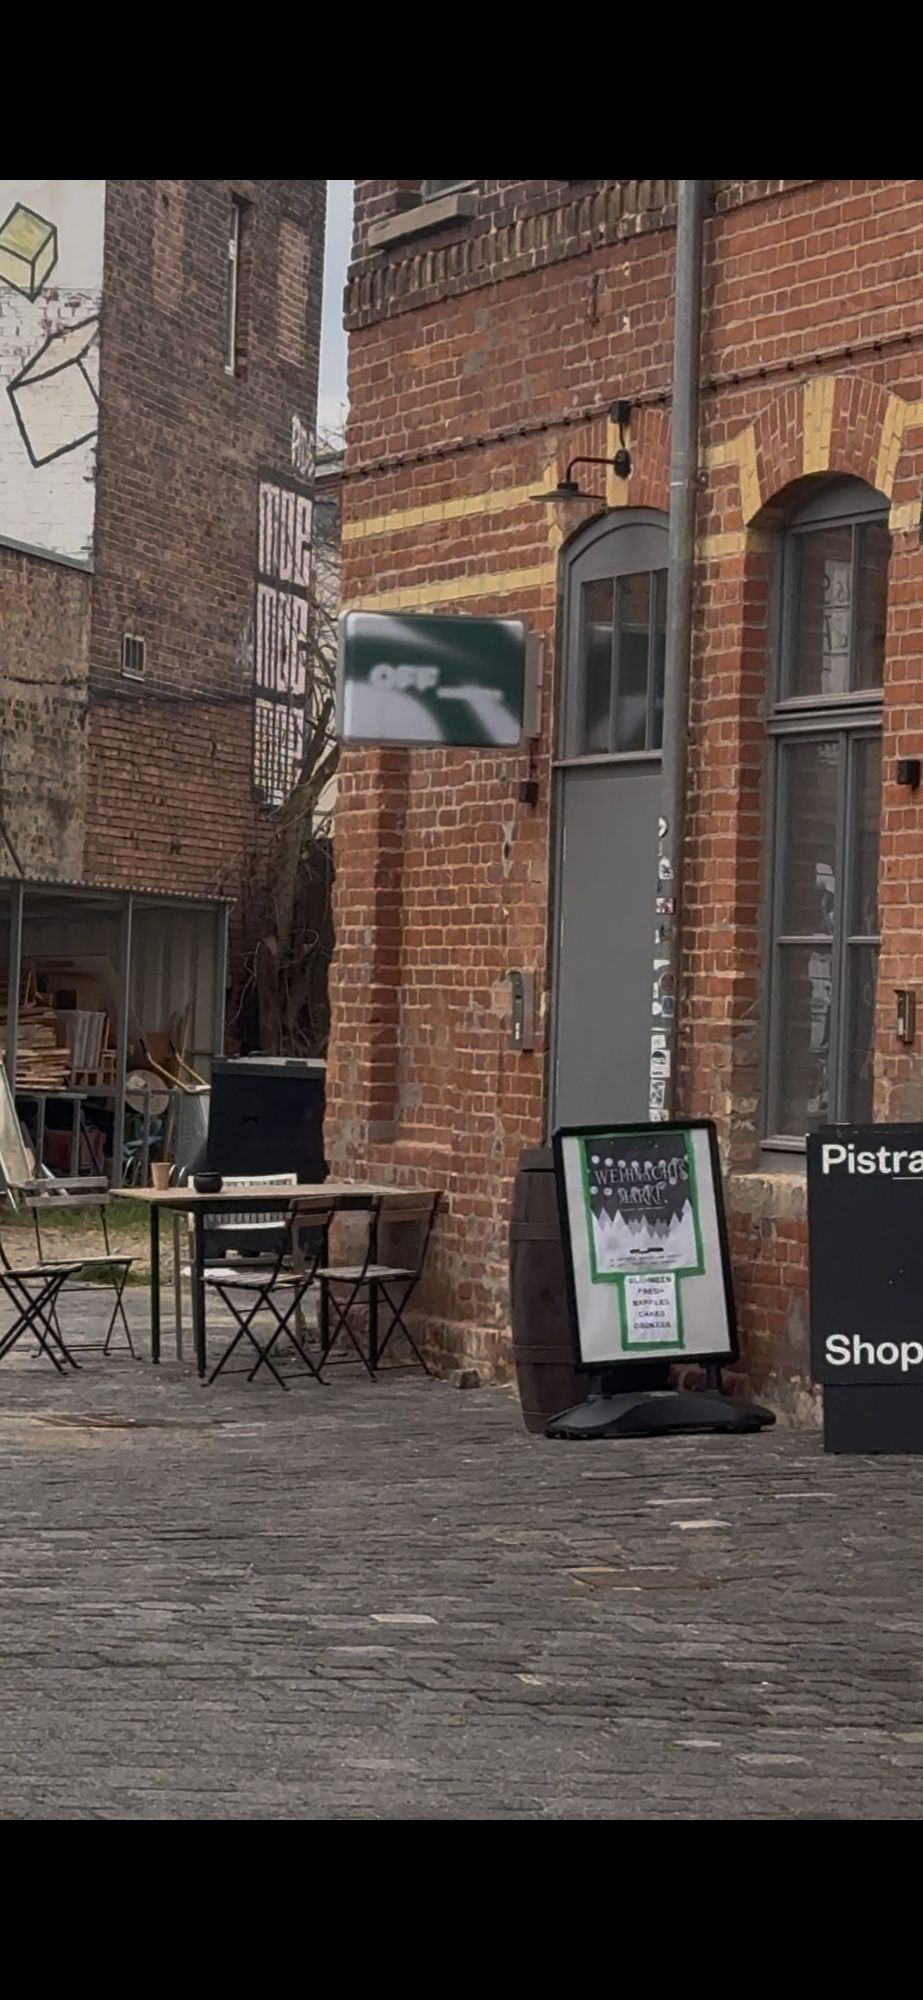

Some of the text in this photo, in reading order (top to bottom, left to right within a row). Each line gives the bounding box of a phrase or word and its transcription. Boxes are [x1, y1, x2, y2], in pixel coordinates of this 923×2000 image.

[369, 664, 439, 690] OFF
[632, 1299, 670, 1307] WAFFLES
[638, 1310, 666, 1318] CAKES
[633, 1321, 672, 1330] COOKIES
[825, 1334, 923, 1372] Shop
